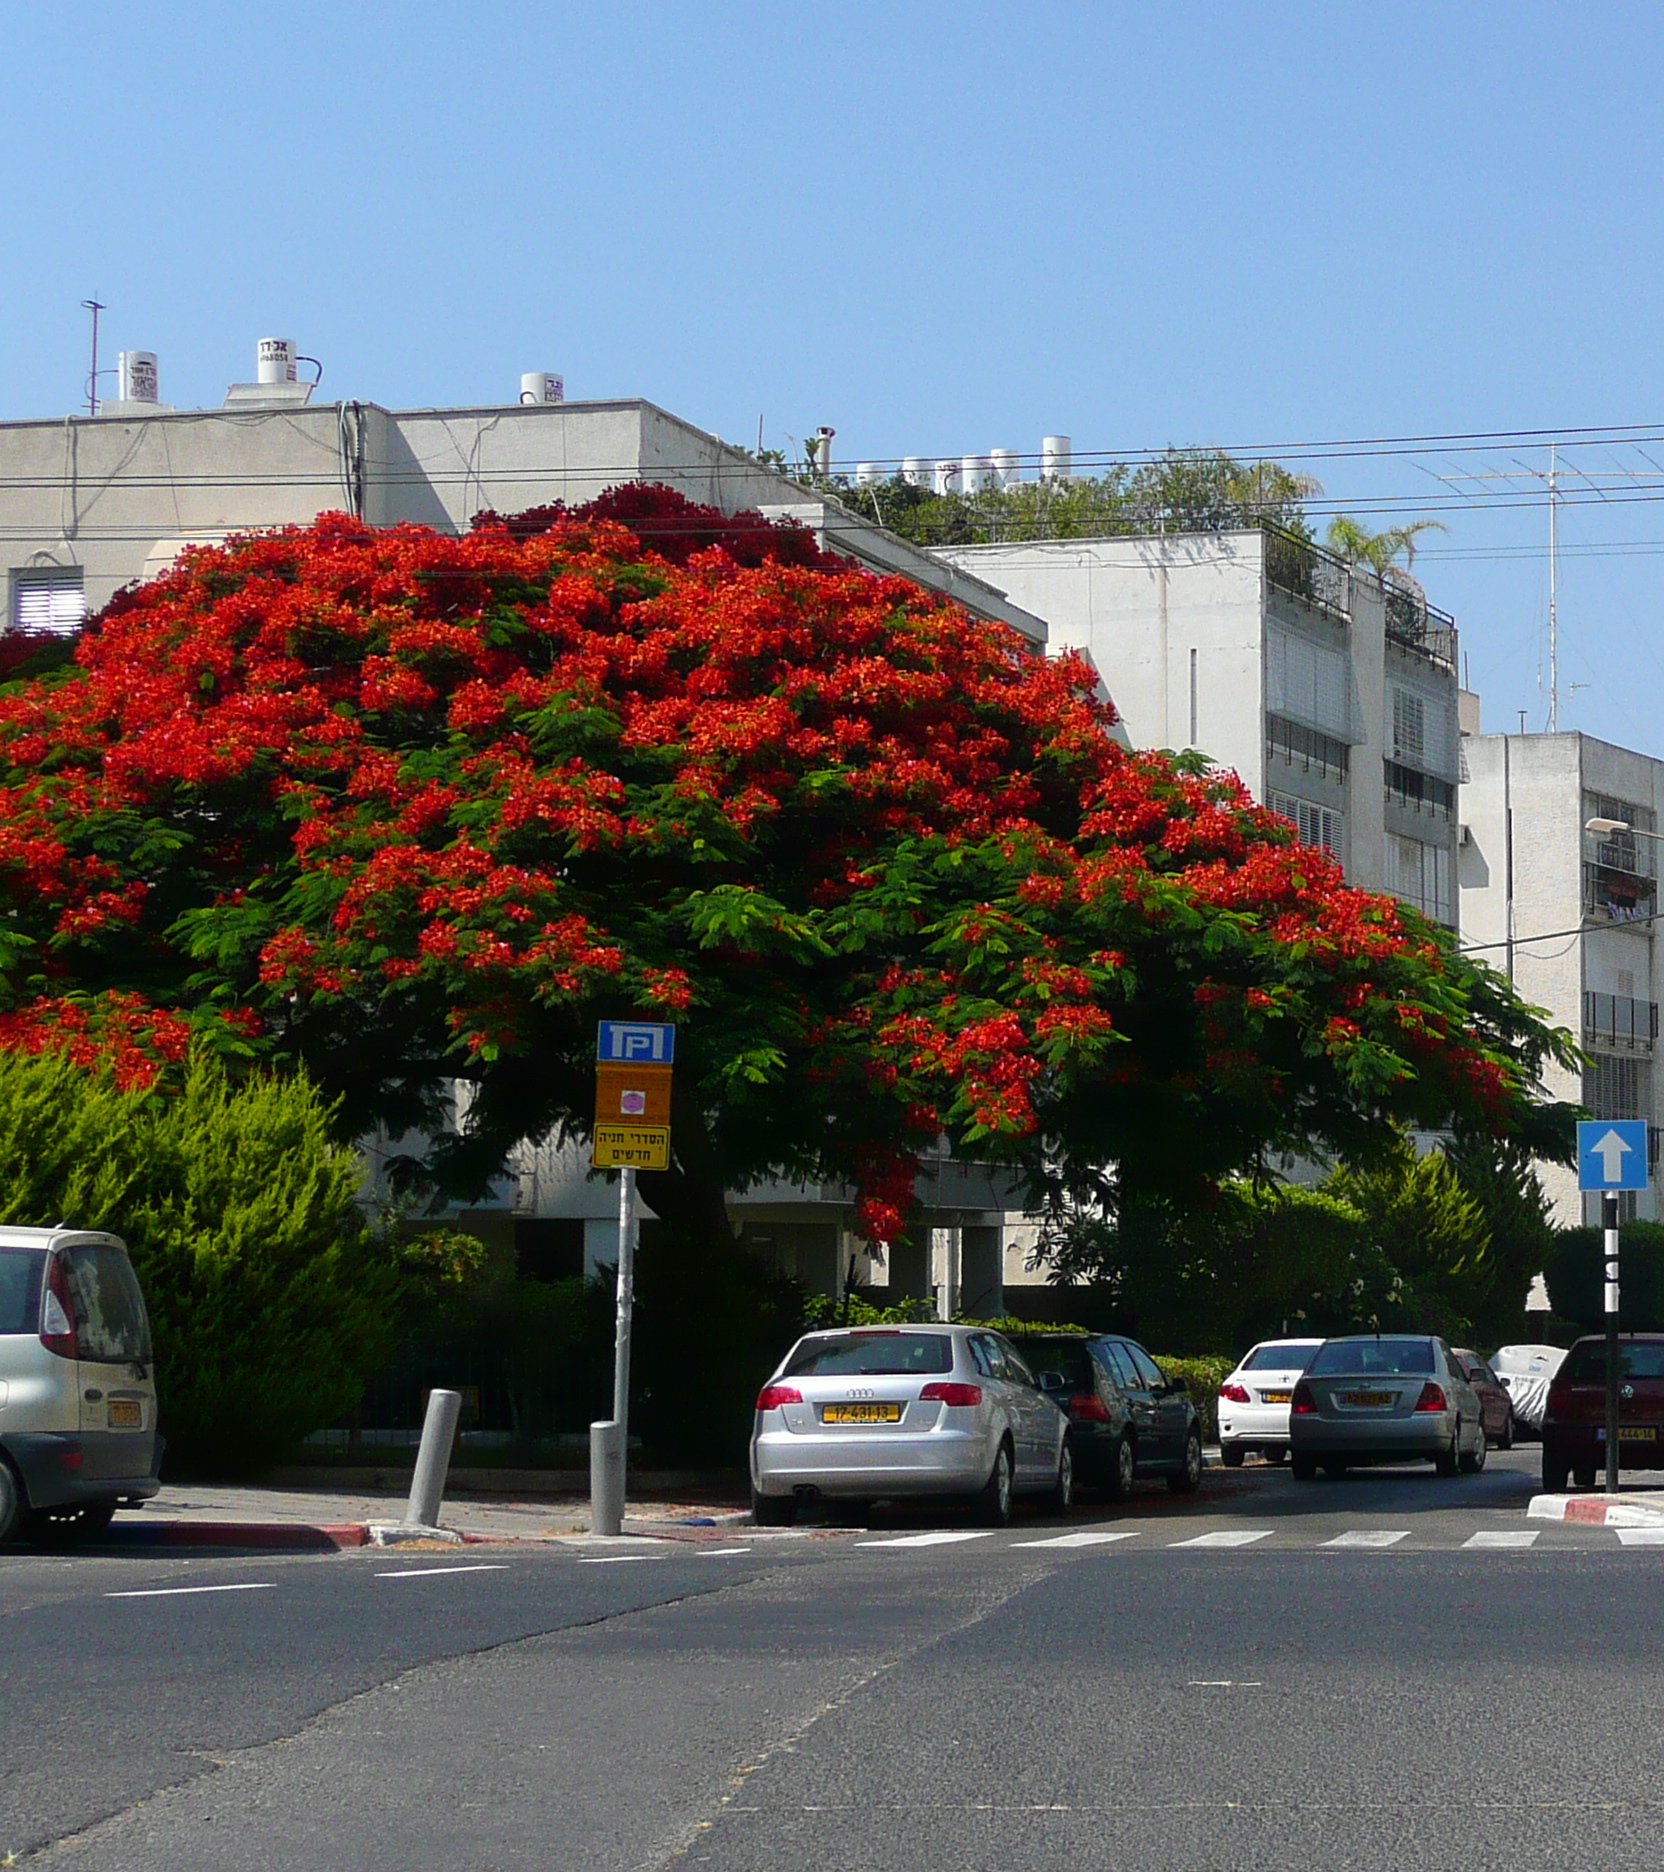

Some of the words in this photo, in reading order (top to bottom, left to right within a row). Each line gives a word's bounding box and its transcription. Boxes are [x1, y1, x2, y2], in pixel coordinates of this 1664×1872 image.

[599, 1131, 624, 1144] חניה
[630, 1132, 665, 1146] הסדרי
[612, 1149, 651, 1161] חדשים
[834, 1406, 889, 1419] 17-431-13
[1620, 1428, 1654, 1440] 444-14
